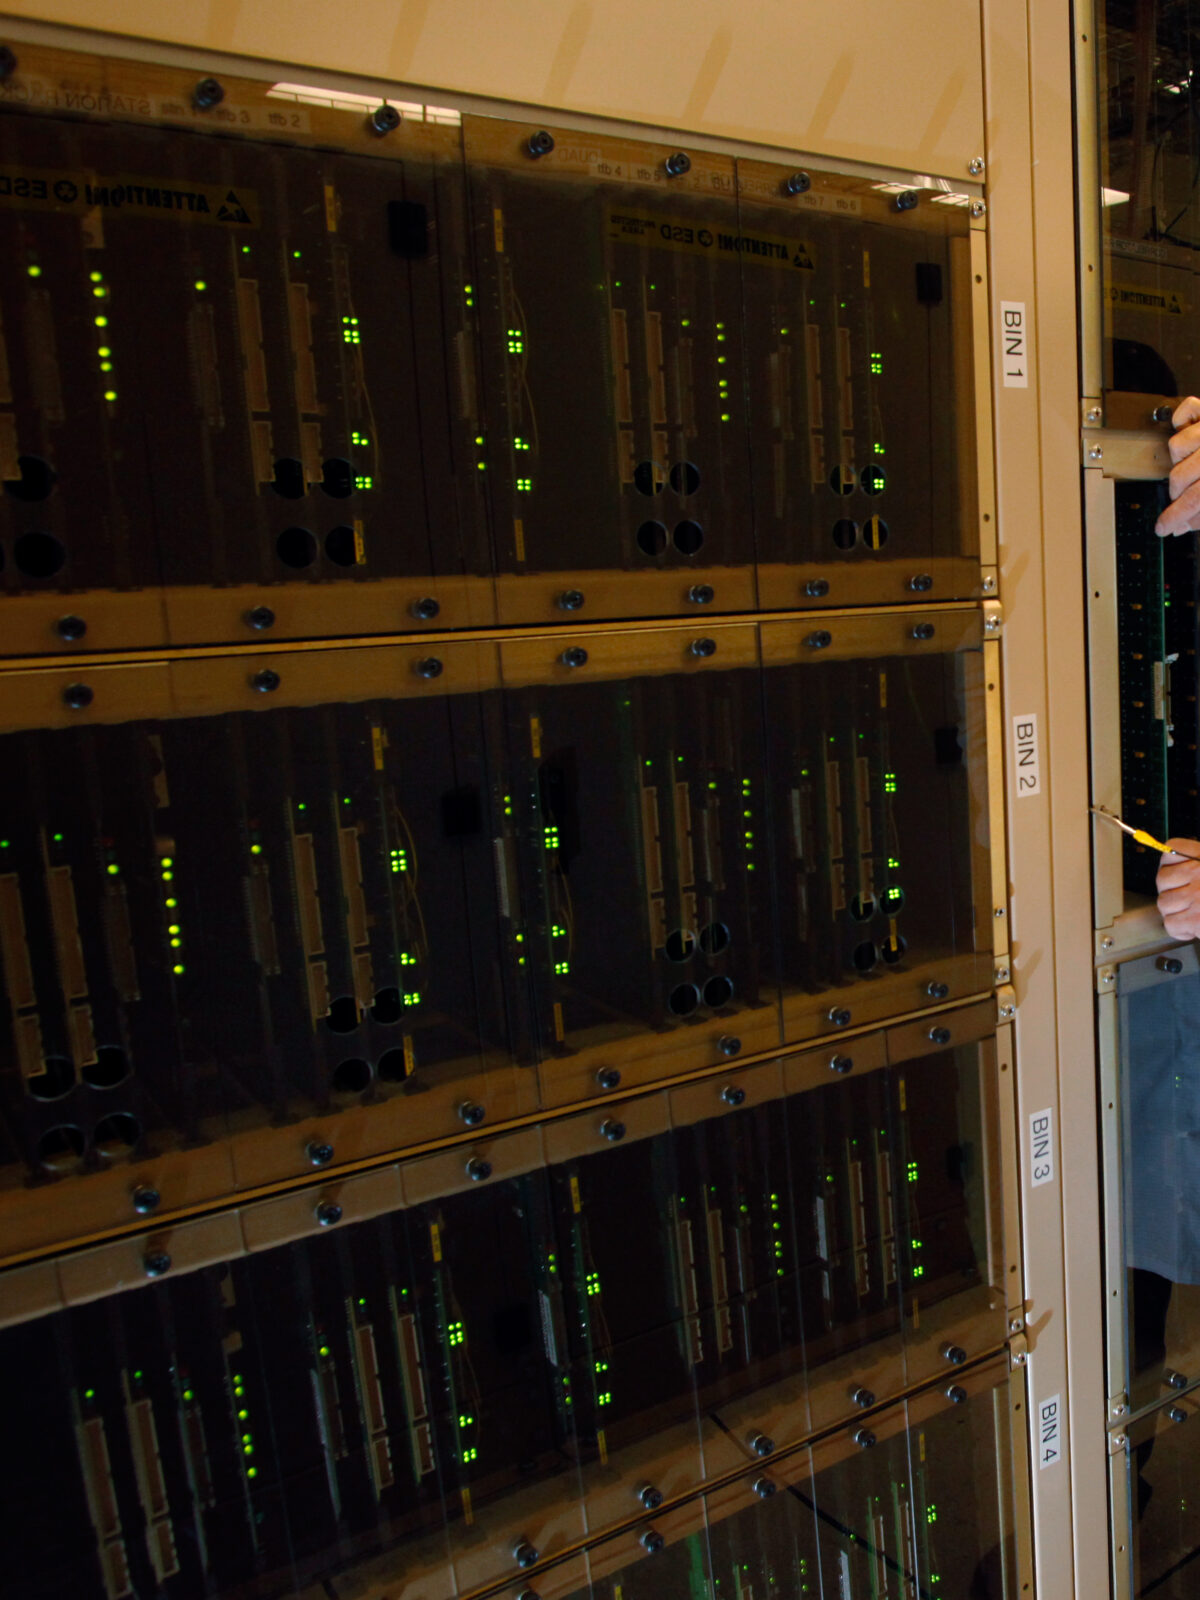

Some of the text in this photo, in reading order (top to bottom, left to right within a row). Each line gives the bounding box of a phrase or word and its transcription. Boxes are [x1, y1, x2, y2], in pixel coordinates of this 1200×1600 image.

[291, 114, 301, 128] 2
[1004, 310, 1024, 377] BIN 1
[1016, 722, 1037, 791] BIN 2
[1032, 1116, 1050, 1180] BIN 3
[1042, 1402, 1058, 1462] BIN 4
